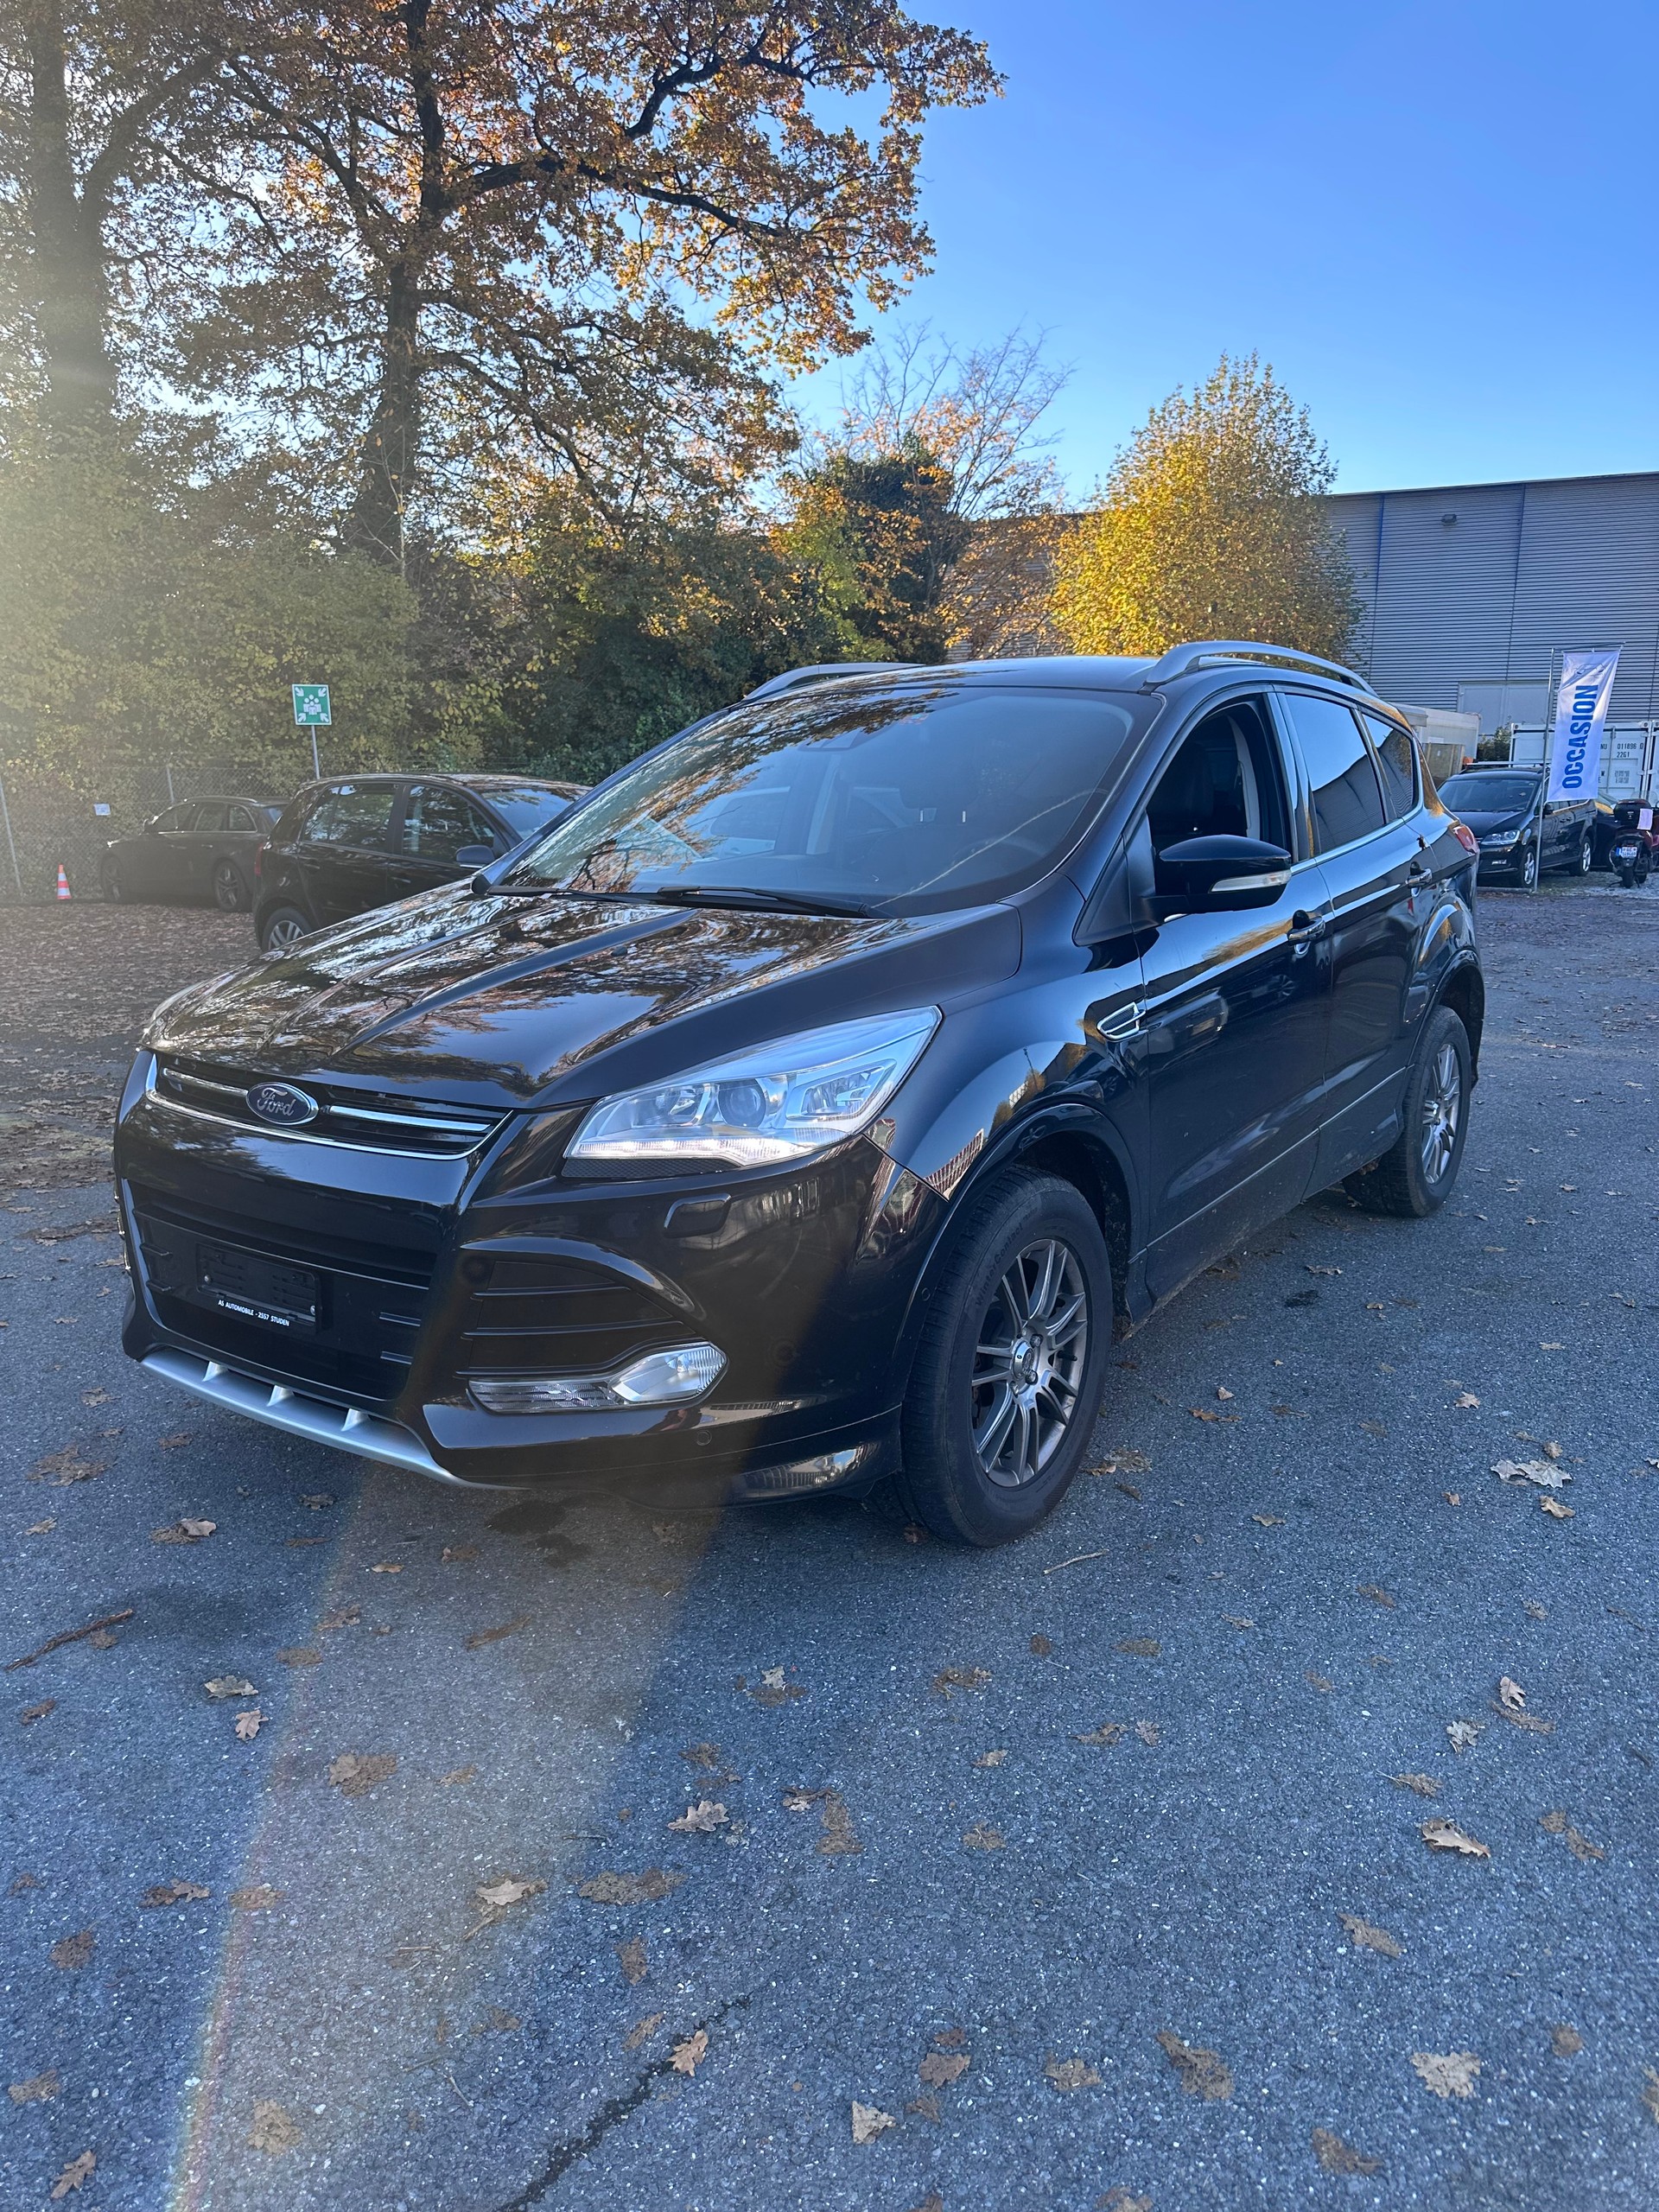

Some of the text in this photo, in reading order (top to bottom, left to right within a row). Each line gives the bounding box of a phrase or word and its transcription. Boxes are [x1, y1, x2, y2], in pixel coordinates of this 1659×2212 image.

[1561, 684, 1599, 789] OCCASION
[256, 1087, 296, 1116] Ford
[226, 1302, 254, 1316] AUTOMOBILE
[258, 1312, 270, 1320] 2557
[270, 1316, 289, 1326] STUDEN
